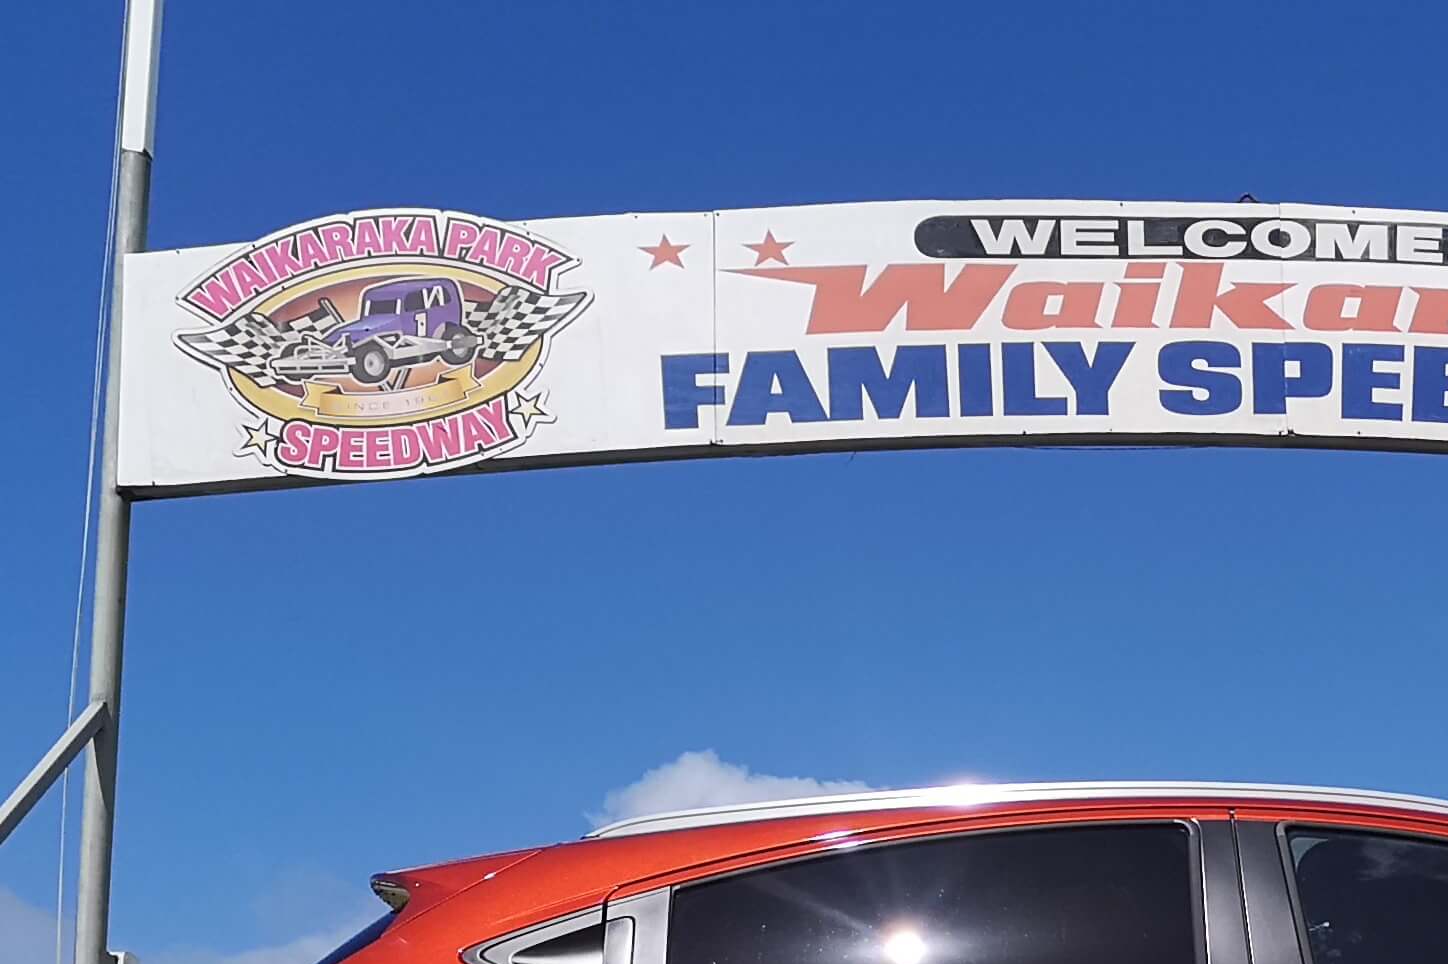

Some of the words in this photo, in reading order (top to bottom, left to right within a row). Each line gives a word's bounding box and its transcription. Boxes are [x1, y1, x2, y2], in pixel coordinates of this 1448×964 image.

[188, 215, 440, 319] WAIKARAKA
[446, 219, 565, 288] PARK
[970, 218, 1443, 264] WELCOME
[661, 341, 1136, 430] FAMILY
[279, 400, 514, 468] SPEEDWAY
